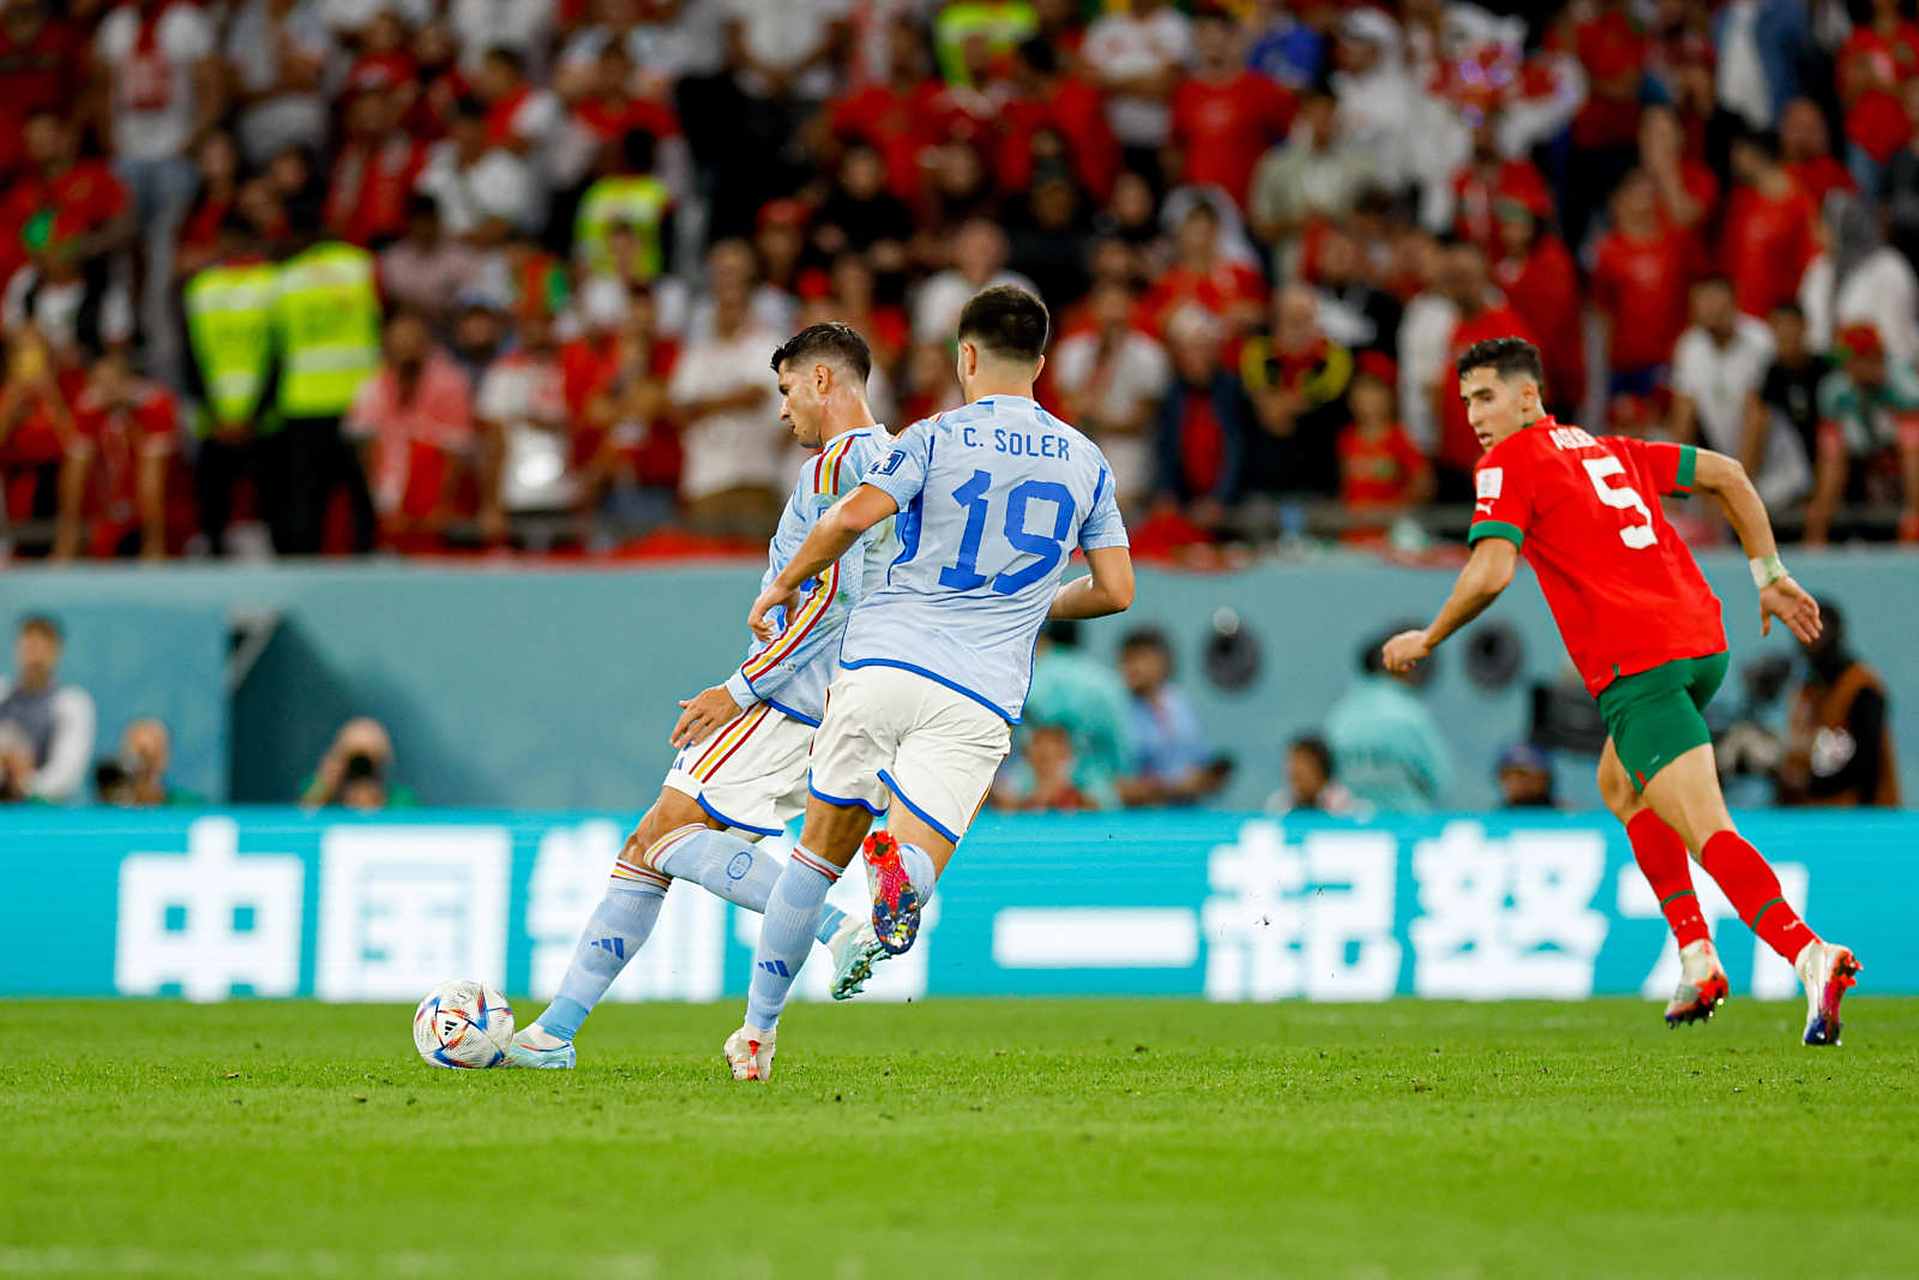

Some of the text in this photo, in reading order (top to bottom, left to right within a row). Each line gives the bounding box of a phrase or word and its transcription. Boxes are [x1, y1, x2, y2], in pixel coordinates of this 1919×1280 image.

[963, 426, 1070, 462] C. SOLER
[938, 469, 1076, 596] 19
[1582, 455, 1658, 550] 5
